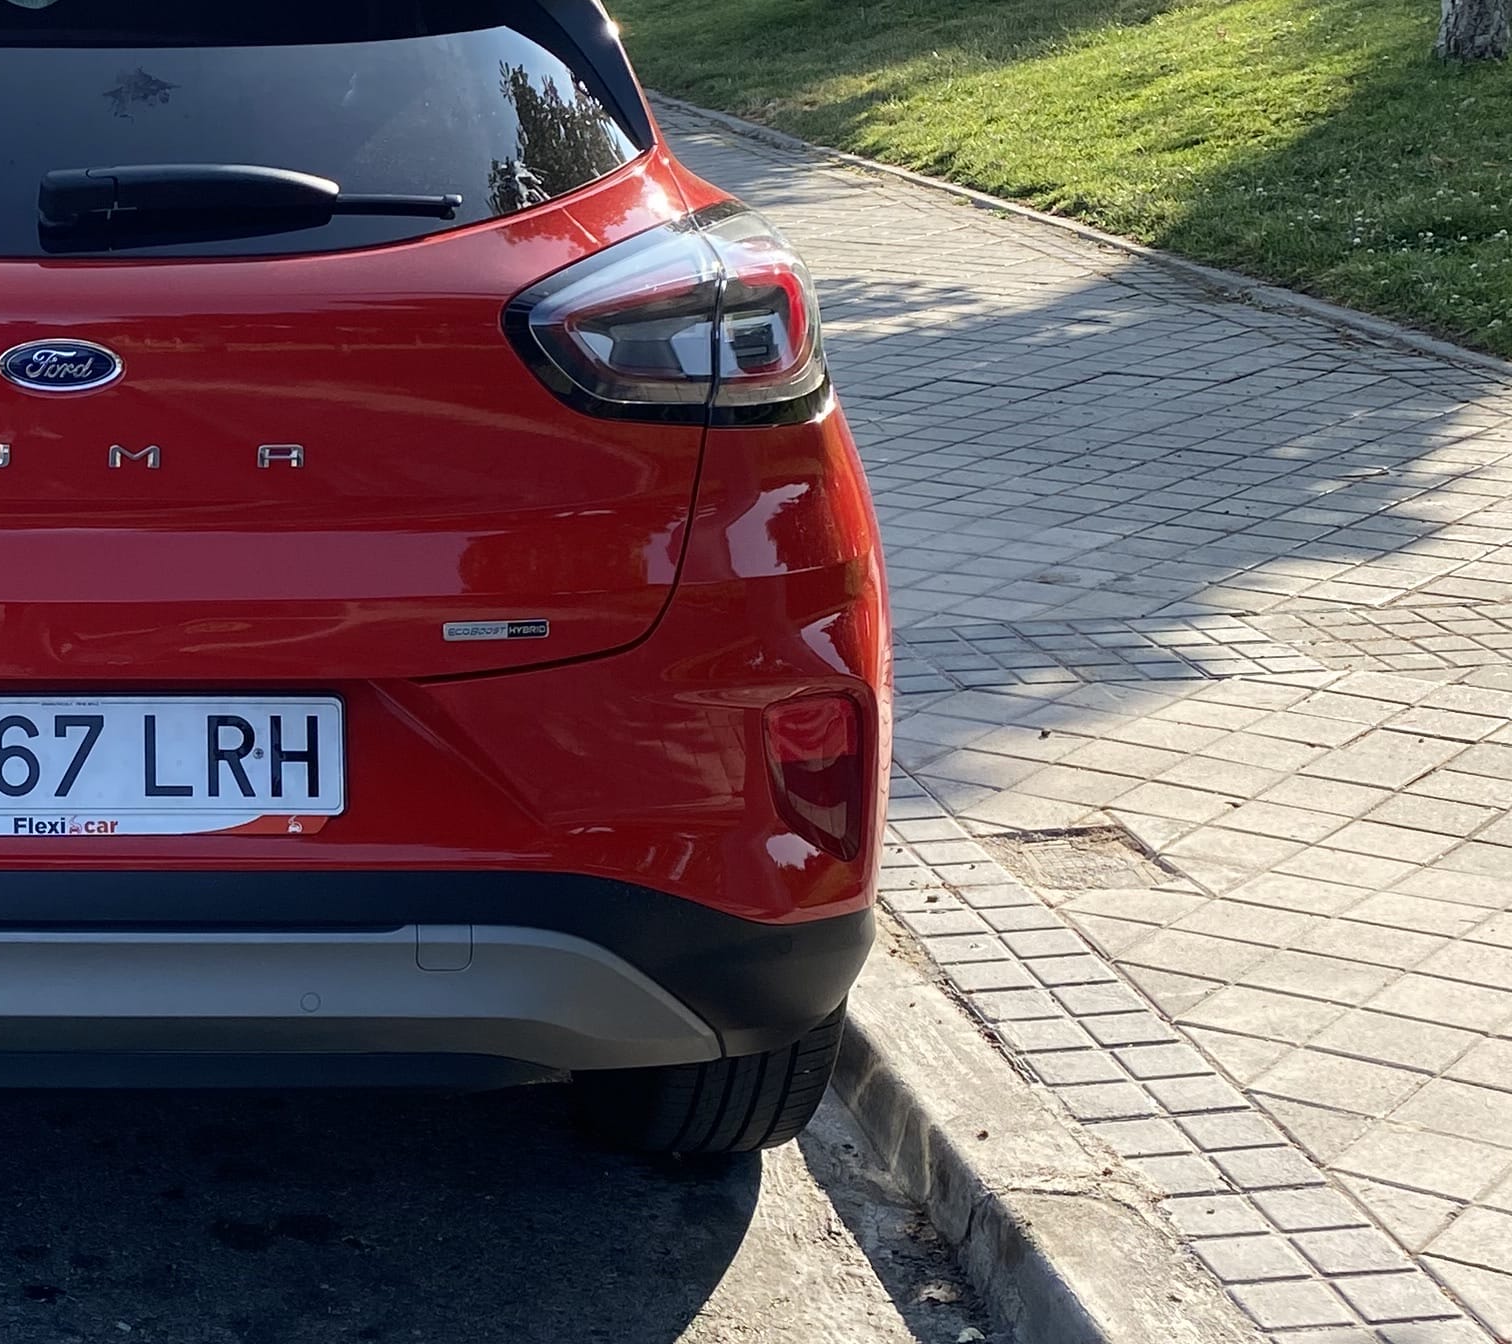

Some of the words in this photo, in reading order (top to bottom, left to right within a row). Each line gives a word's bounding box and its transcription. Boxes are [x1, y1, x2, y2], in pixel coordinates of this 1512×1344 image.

[26, 349, 93, 378] Ford
[508, 625, 546, 634] HYBRID
[144, 714, 319, 798] LRH
